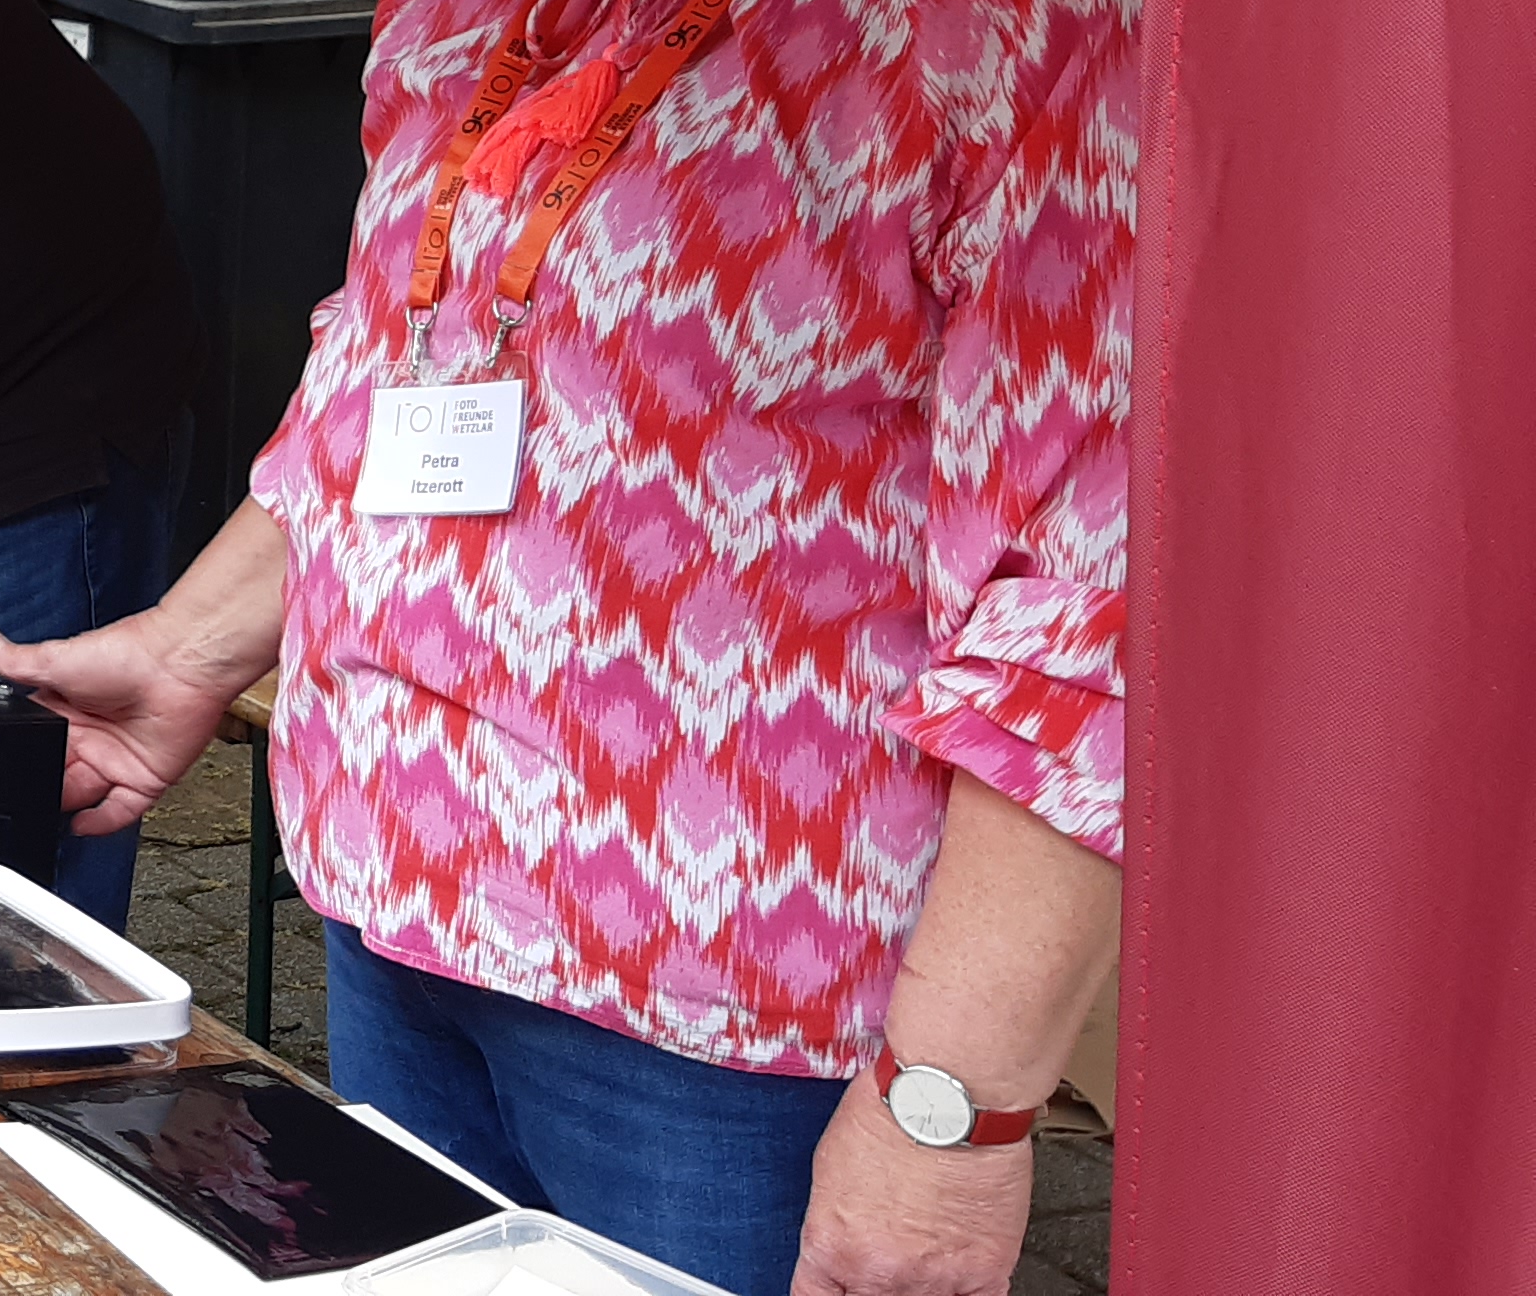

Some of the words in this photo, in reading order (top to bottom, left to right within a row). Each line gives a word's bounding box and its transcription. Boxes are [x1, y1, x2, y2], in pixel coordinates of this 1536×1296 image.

[663, 19, 700, 51] 95
[461, 106, 491, 137] 95
[542, 180, 574, 211] 95
[454, 399, 478, 411] FOTO
[453, 409, 494, 423] FREUNDE
[452, 421, 494, 435] WETZLAR
[421, 454, 460, 469] Petra
[410, 479, 464, 494] Itzerott
